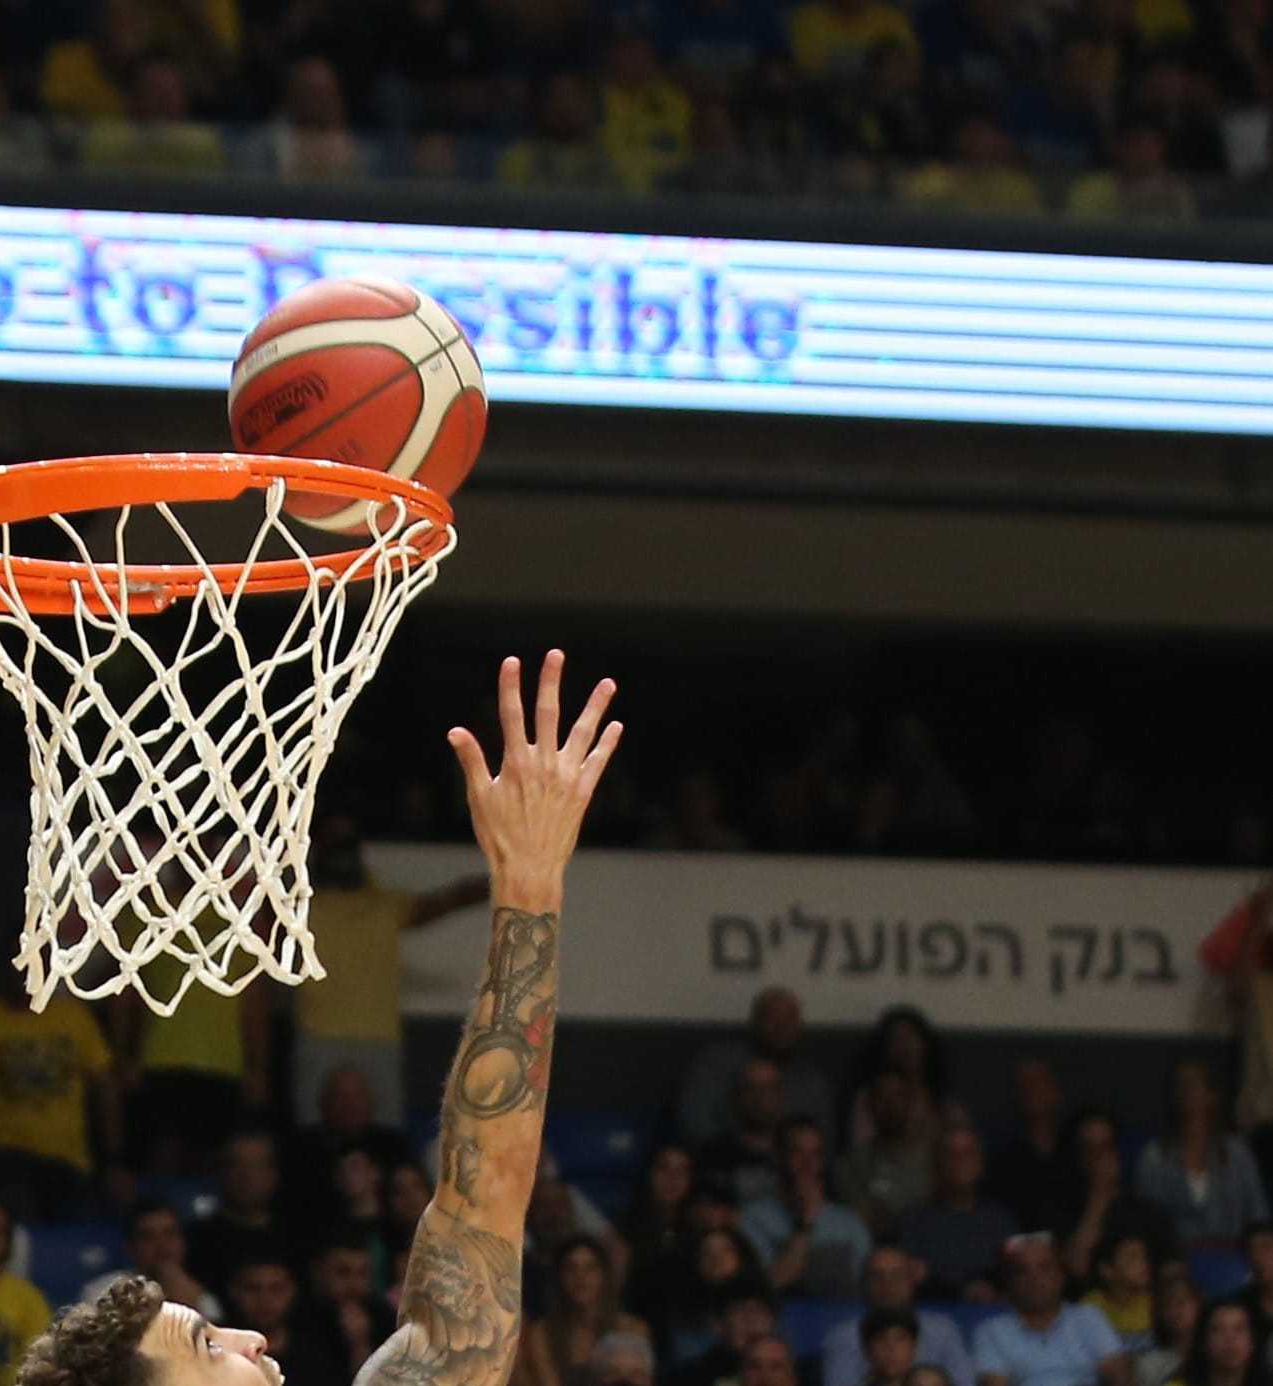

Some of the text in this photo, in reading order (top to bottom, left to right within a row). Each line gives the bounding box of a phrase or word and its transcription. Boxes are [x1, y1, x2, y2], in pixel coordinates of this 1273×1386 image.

[78, 236, 197, 337] to
[709, 904, 1180, 996] בנק הפועלים
